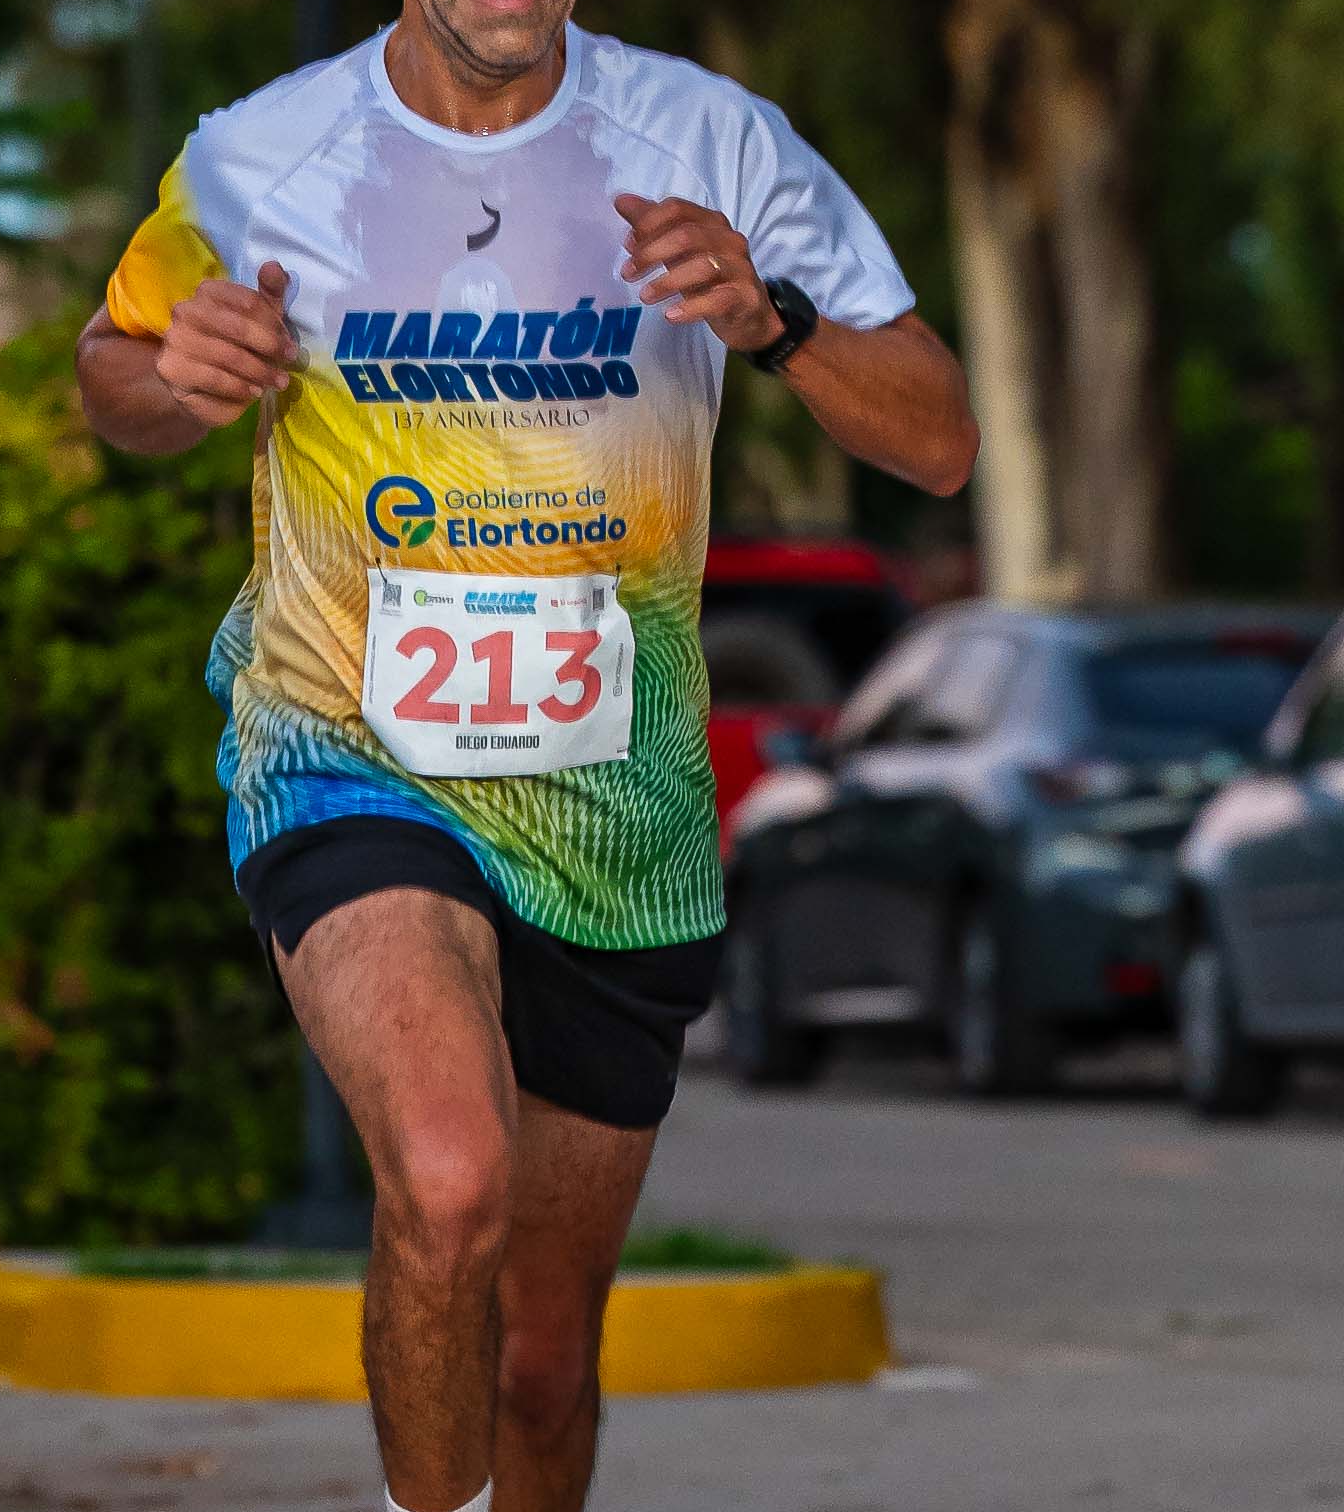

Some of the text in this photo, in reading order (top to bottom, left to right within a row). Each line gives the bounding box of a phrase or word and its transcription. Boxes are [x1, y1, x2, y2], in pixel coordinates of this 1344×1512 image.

[334, 297, 642, 361] MARATÓN
[335, 360, 641, 404] ELORTONDO
[394, 407, 591, 430] 137 ANIVERSARIO
[444, 485, 607, 511] Gobierno de
[446, 513, 627, 548] Elortondo
[393, 627, 602, 725] 213
[455, 734, 540, 750] DIEGO EDUARDO
